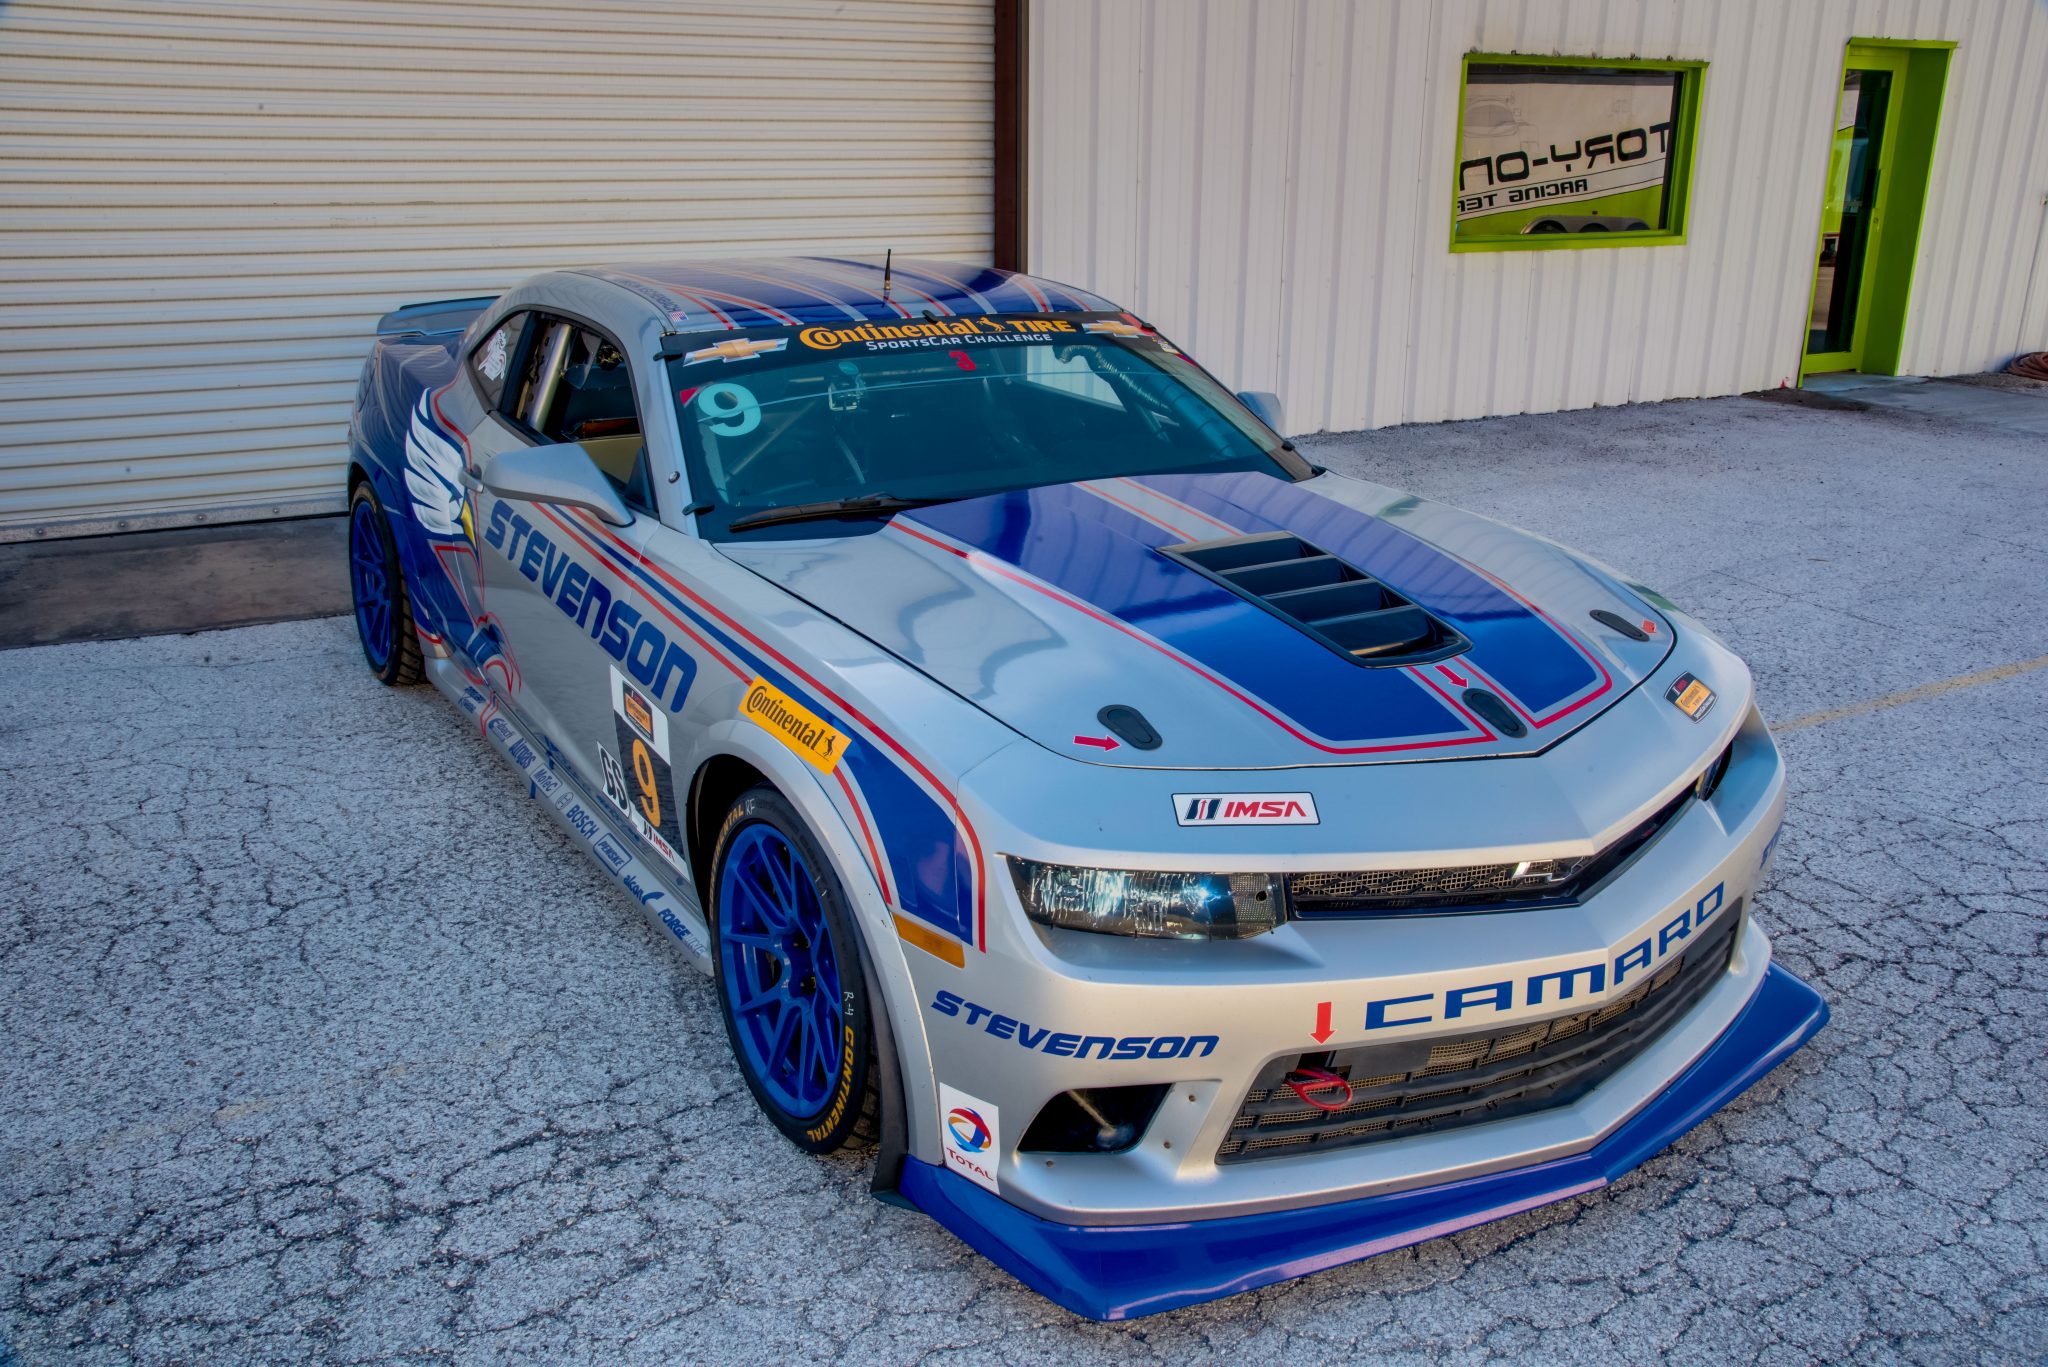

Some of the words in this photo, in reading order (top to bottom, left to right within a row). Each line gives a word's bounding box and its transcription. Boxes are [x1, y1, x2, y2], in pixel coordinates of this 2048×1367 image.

[800, 318, 981, 350] Continental
[1007, 320, 1077, 333] TIRE
[698, 383, 761, 436] 9
[484, 500, 698, 713] STEVENSON
[747, 686, 825, 750] Continental
[533, 768, 558, 792] MoTeC
[600, 748, 628, 810] GS
[633, 739, 660, 827] 9
[566, 804, 599, 839] BOSCH
[1224, 801, 1306, 818] IMSA
[598, 840, 625, 867] PENSKE
[653, 833, 675, 862] IMSA
[624, 875, 644, 901] alcon
[1364, 881, 1725, 1030] CAMARO
[930, 990, 1219, 1060] STEVENSON
[806, 1025, 855, 1143] CONTINENTAL
[946, 1147, 993, 1181] TOTAL
